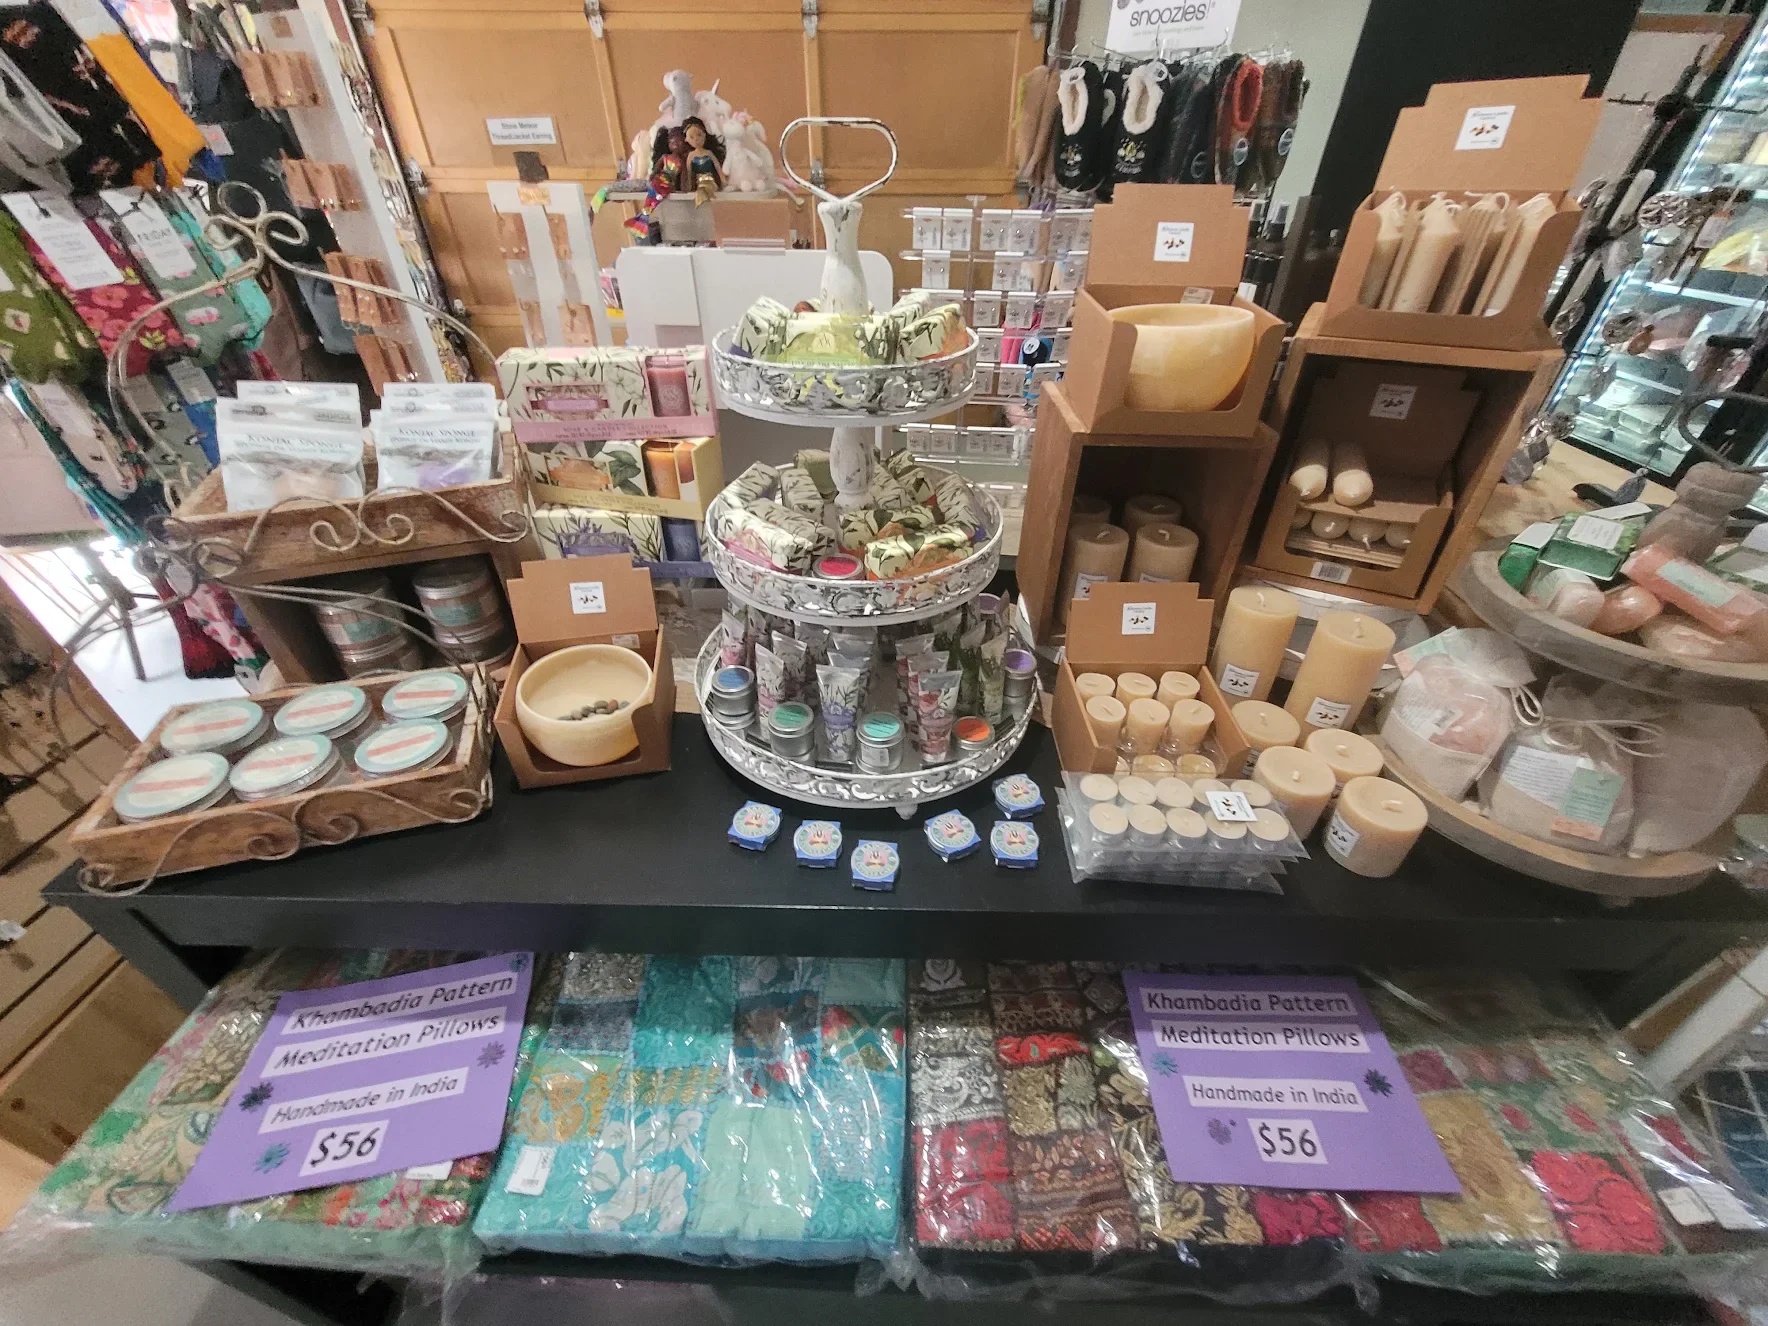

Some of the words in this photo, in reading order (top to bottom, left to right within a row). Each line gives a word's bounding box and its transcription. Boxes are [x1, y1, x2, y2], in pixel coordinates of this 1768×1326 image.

[291, 992, 423, 1030] Khambadia
[429, 976, 514, 1006] Pattern
[1147, 992, 1262, 1012] Khambadia
[1268, 994, 1350, 1012] Pattern
[273, 1030, 411, 1071] Meditation
[417, 1012, 501, 1044] Pillows
[1161, 1024, 1277, 1046] Meditation
[1284, 1027, 1361, 1047] Pillows
[270, 1093, 381, 1125] Handmade
[386, 1086, 405, 1103] in
[409, 1075, 459, 1099] India
[1192, 1083, 1285, 1103] Handmade
[1290, 1086, 1307, 1103] in
[1312, 1087, 1359, 1106] India
[309, 1126, 381, 1168] $56
[1258, 1121, 1318, 1158] $56
